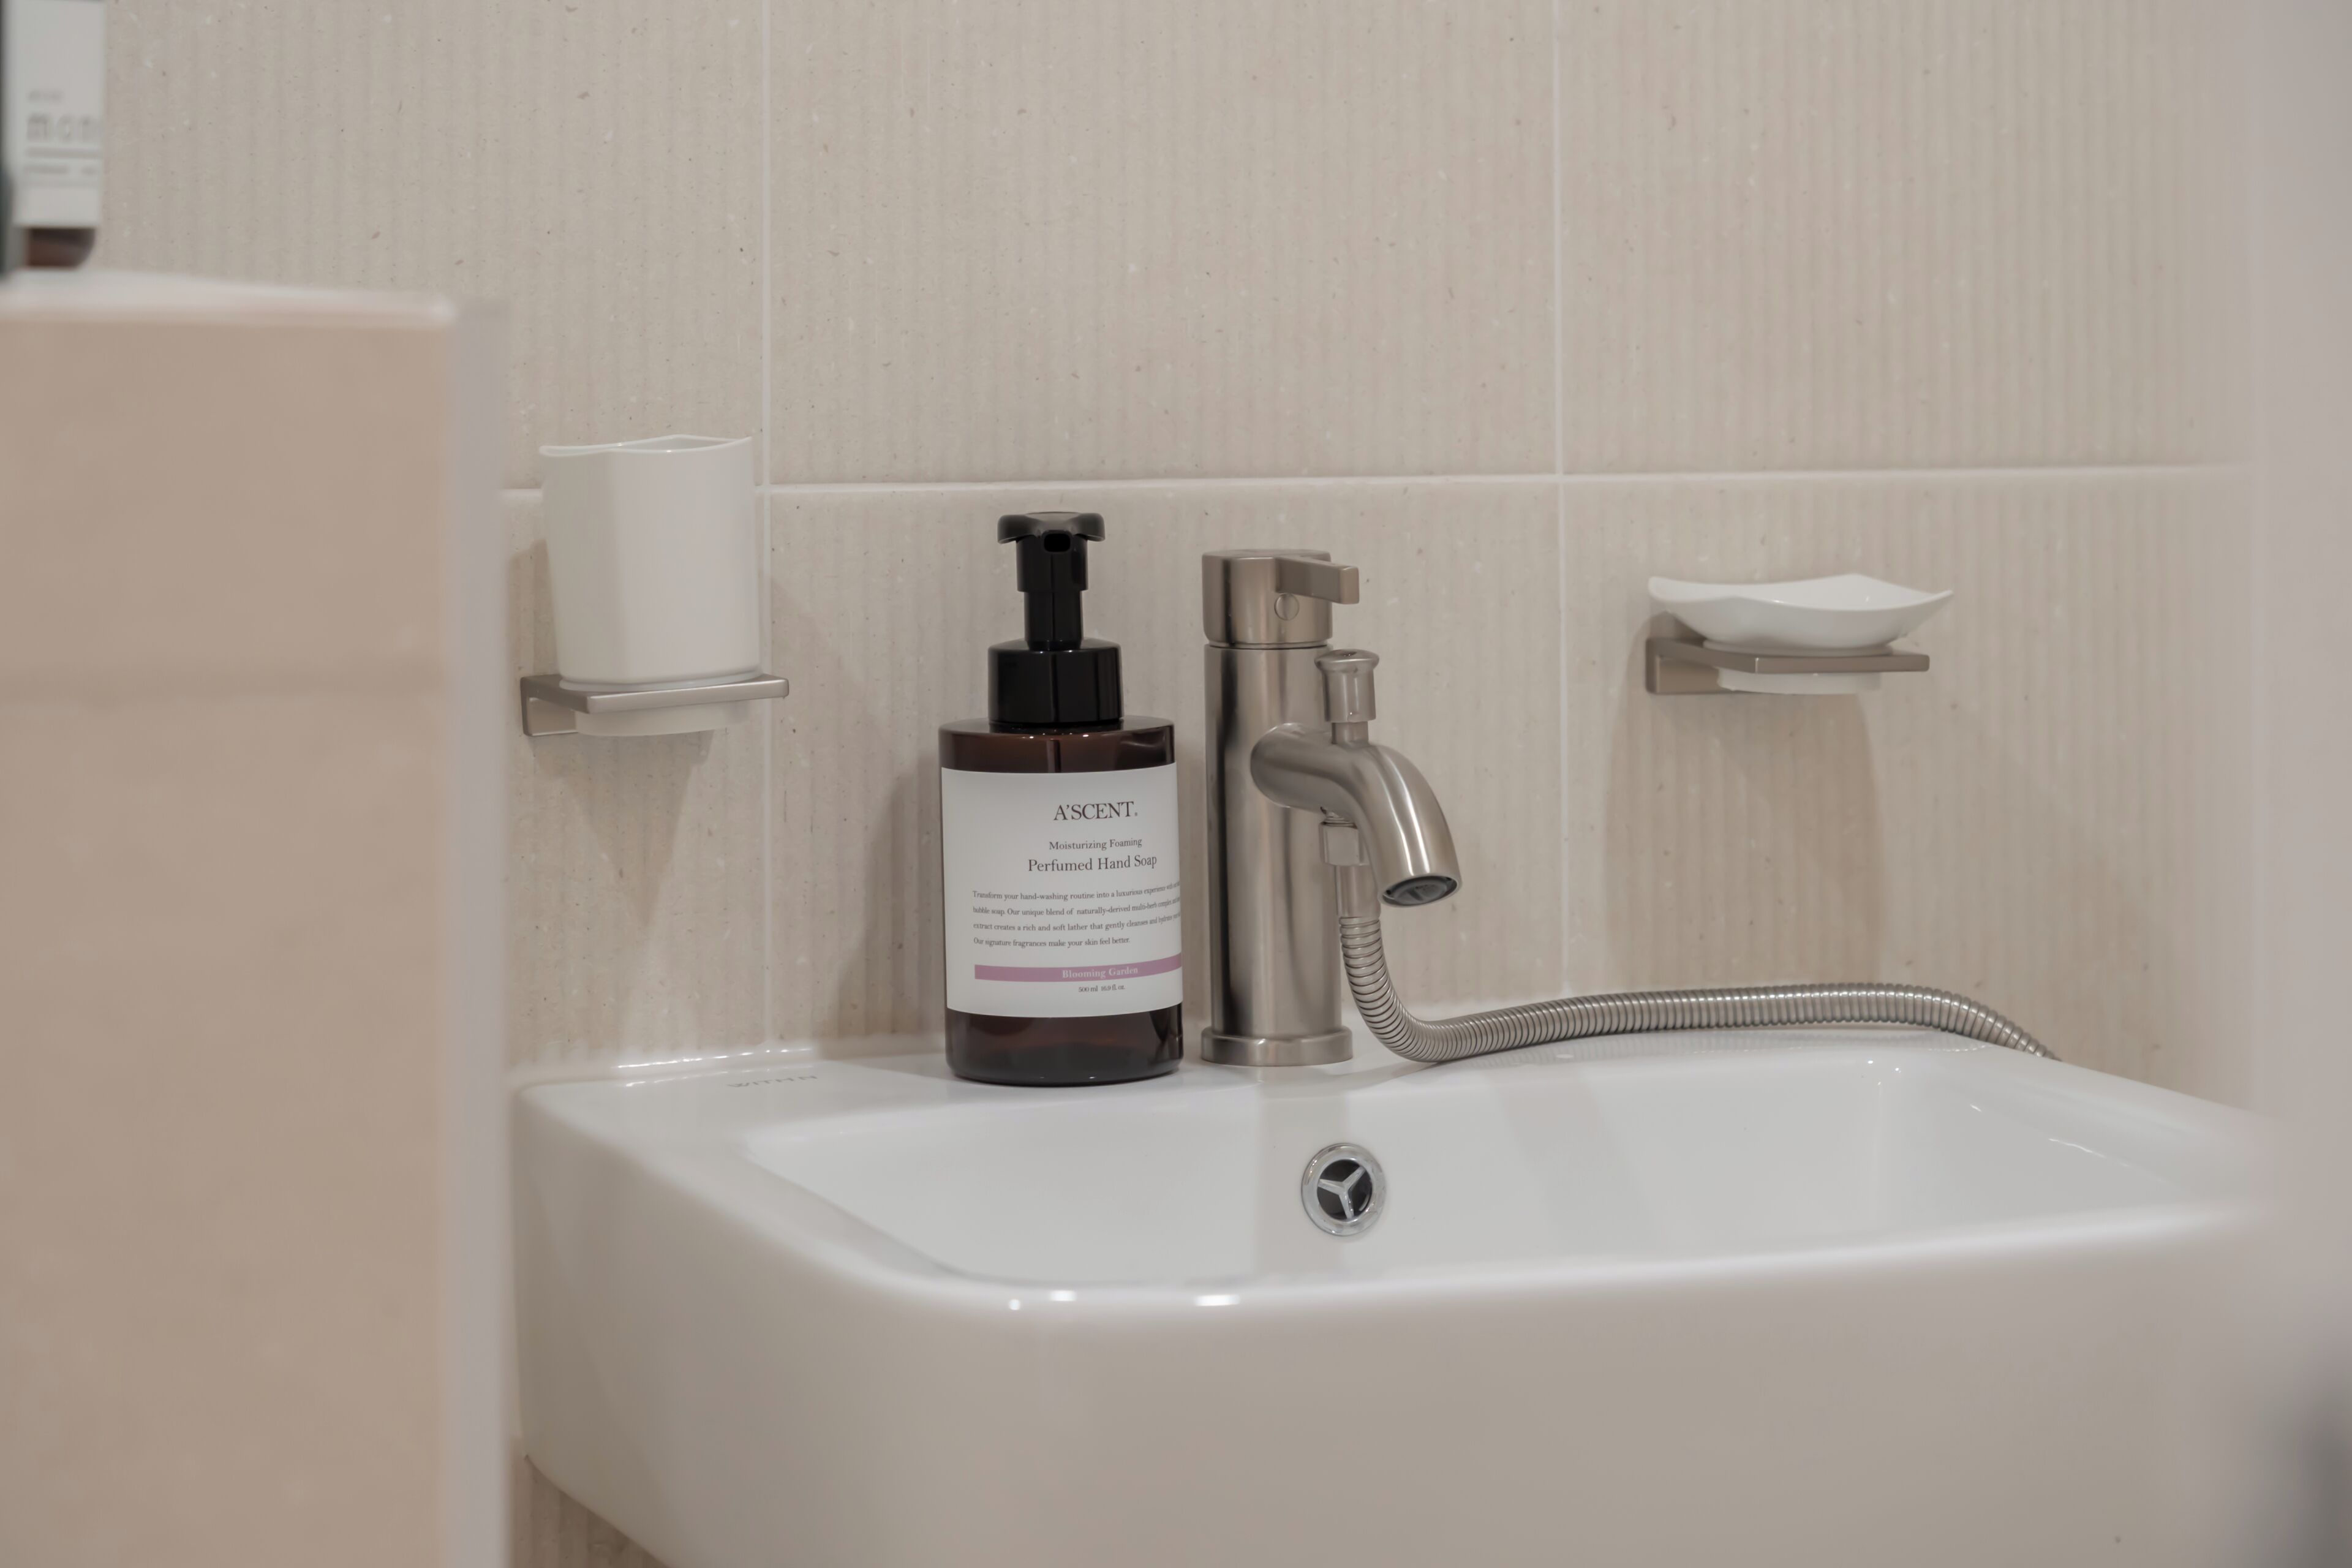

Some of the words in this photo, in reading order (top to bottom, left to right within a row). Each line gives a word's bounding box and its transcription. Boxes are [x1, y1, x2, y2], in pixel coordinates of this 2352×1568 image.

[1049, 840, 1107, 851] Moisturizing
[1110, 838, 1142, 848] Foaming
[1029, 858, 1093, 871] Perfumed
[1098, 855, 1130, 870] Hand
[1134, 855, 1156, 869] Soap
[1020, 892, 1068, 902] hand-washing
[1077, 905, 1130, 916] naturally-derived
[1132, 902, 1157, 911] multi-herb
[1105, 921, 1125, 931] gently
[986, 938, 1011, 948] signature
[1013, 939, 1046, 949] fragrances
[1062, 969, 1106, 979] Blooming
[1109, 967, 1138, 976] Garden
